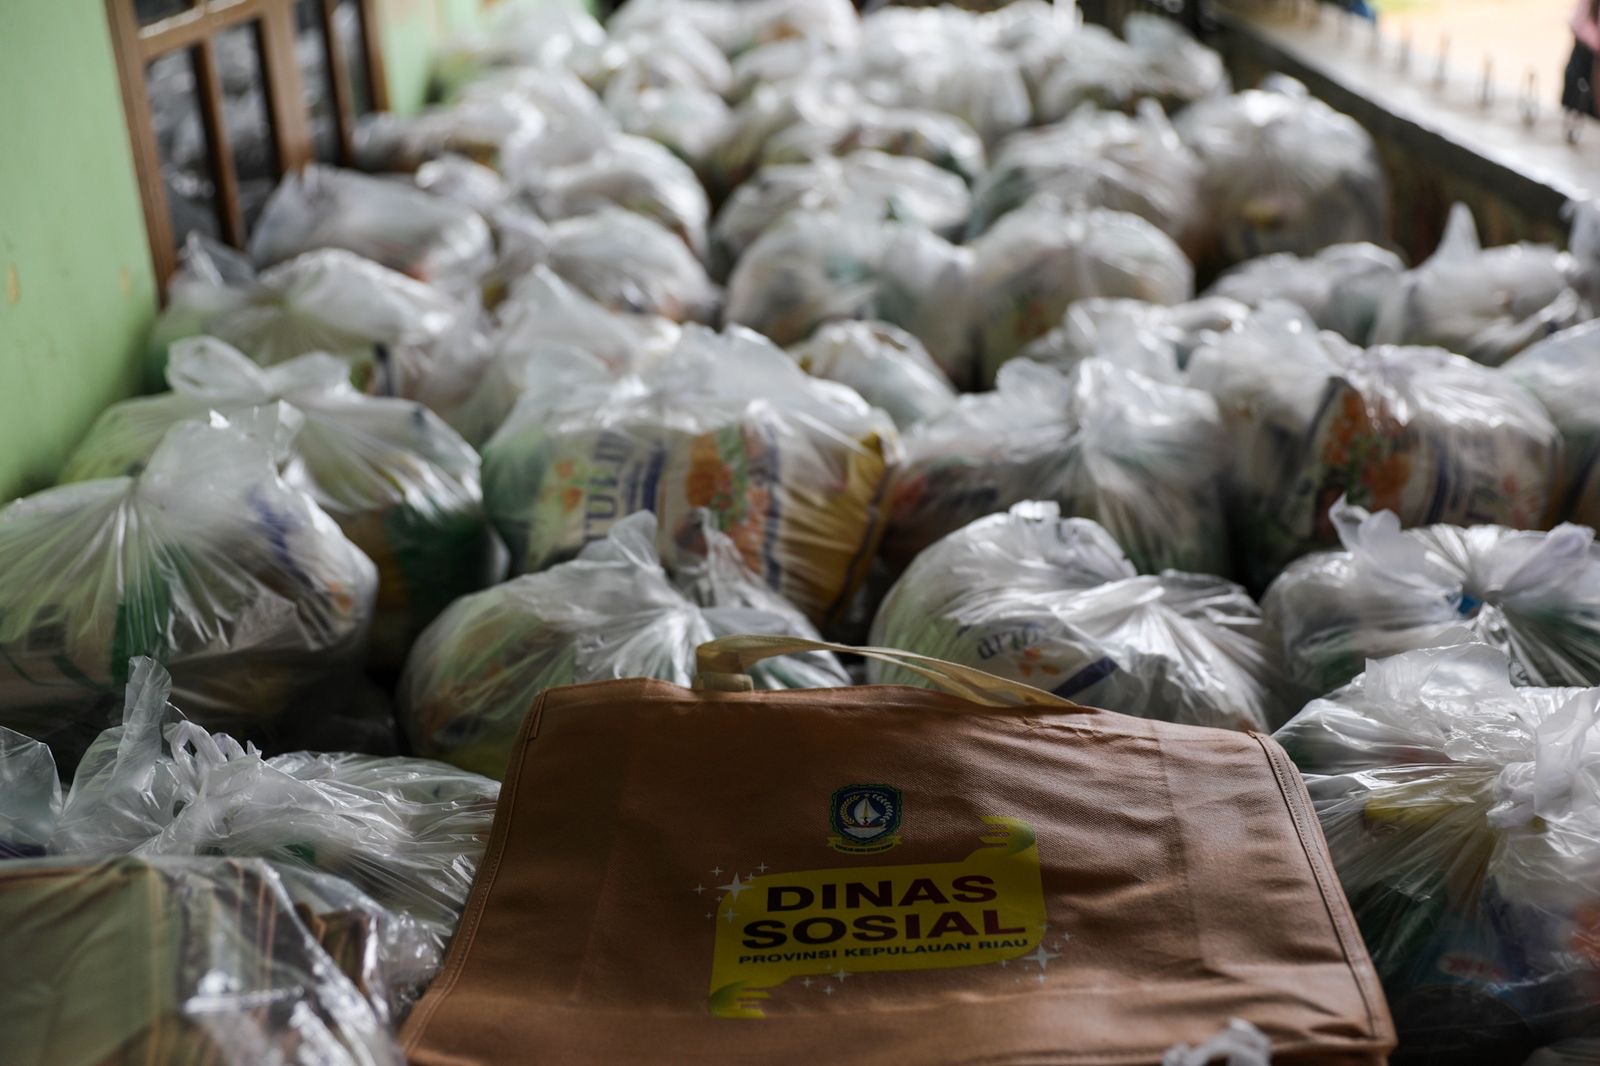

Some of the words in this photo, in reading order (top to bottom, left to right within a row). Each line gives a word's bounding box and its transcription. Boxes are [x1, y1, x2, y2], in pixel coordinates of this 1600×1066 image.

[767, 875, 998, 912] DINAS
[742, 909, 1026, 949] SOSIAL
[738, 949, 838, 964] PROVINSI
[844, 941, 972, 958] KEPULAUAN
[978, 938, 1028, 950] RIAU
